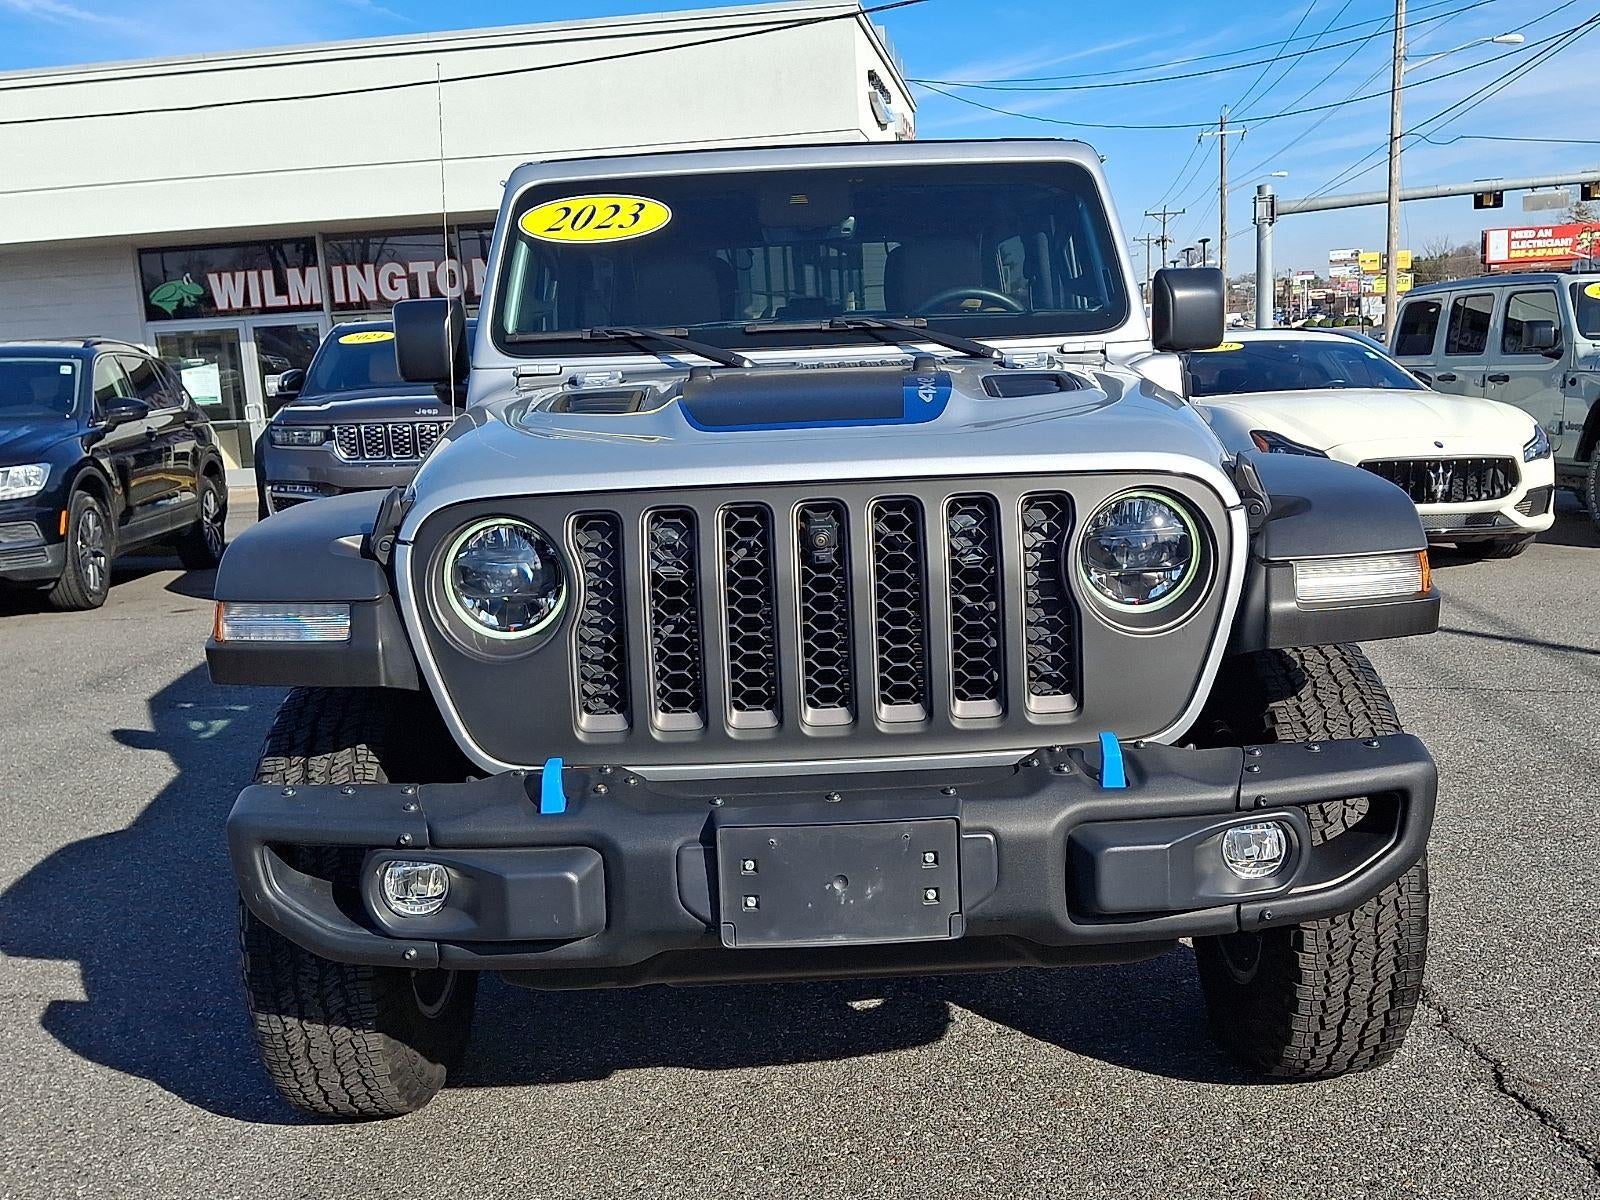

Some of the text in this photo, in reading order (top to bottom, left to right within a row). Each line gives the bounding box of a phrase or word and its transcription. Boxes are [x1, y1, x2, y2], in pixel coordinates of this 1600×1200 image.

[543, 202, 646, 232] 2023
[1511, 229, 1553, 239] NEED AN
[414, 407, 439, 416] Jeep
